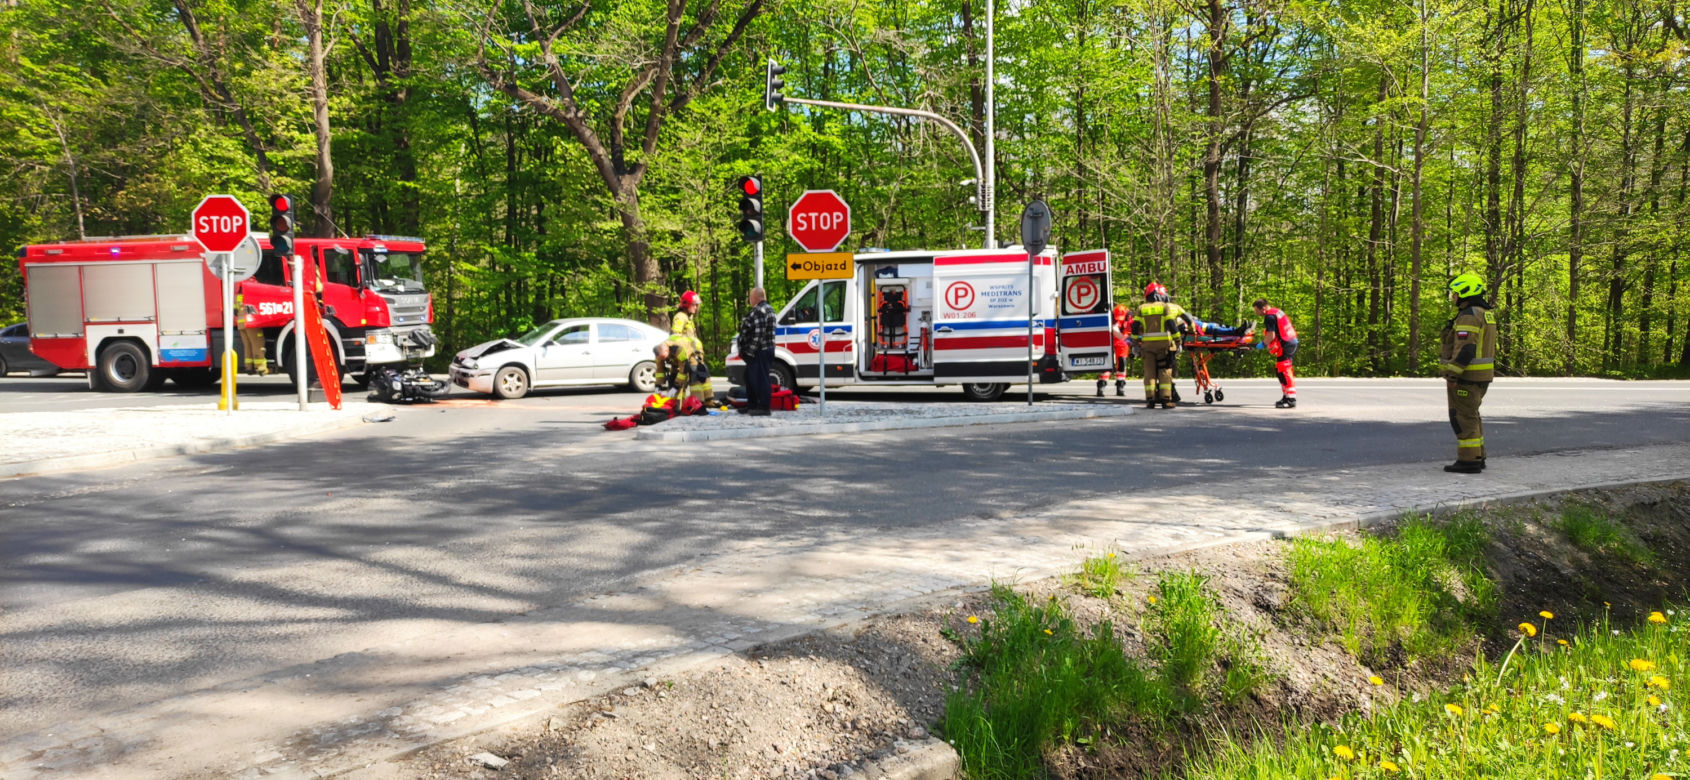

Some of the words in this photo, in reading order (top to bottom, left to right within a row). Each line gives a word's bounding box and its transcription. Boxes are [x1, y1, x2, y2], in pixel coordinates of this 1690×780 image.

[199, 215, 243, 233] STOP
[797, 212, 844, 231] STOP
[803, 260, 847, 273] Objazd
[1066, 262, 1106, 274] AMBU
[954, 287, 969, 305] P
[1077, 284, 1092, 304] P
